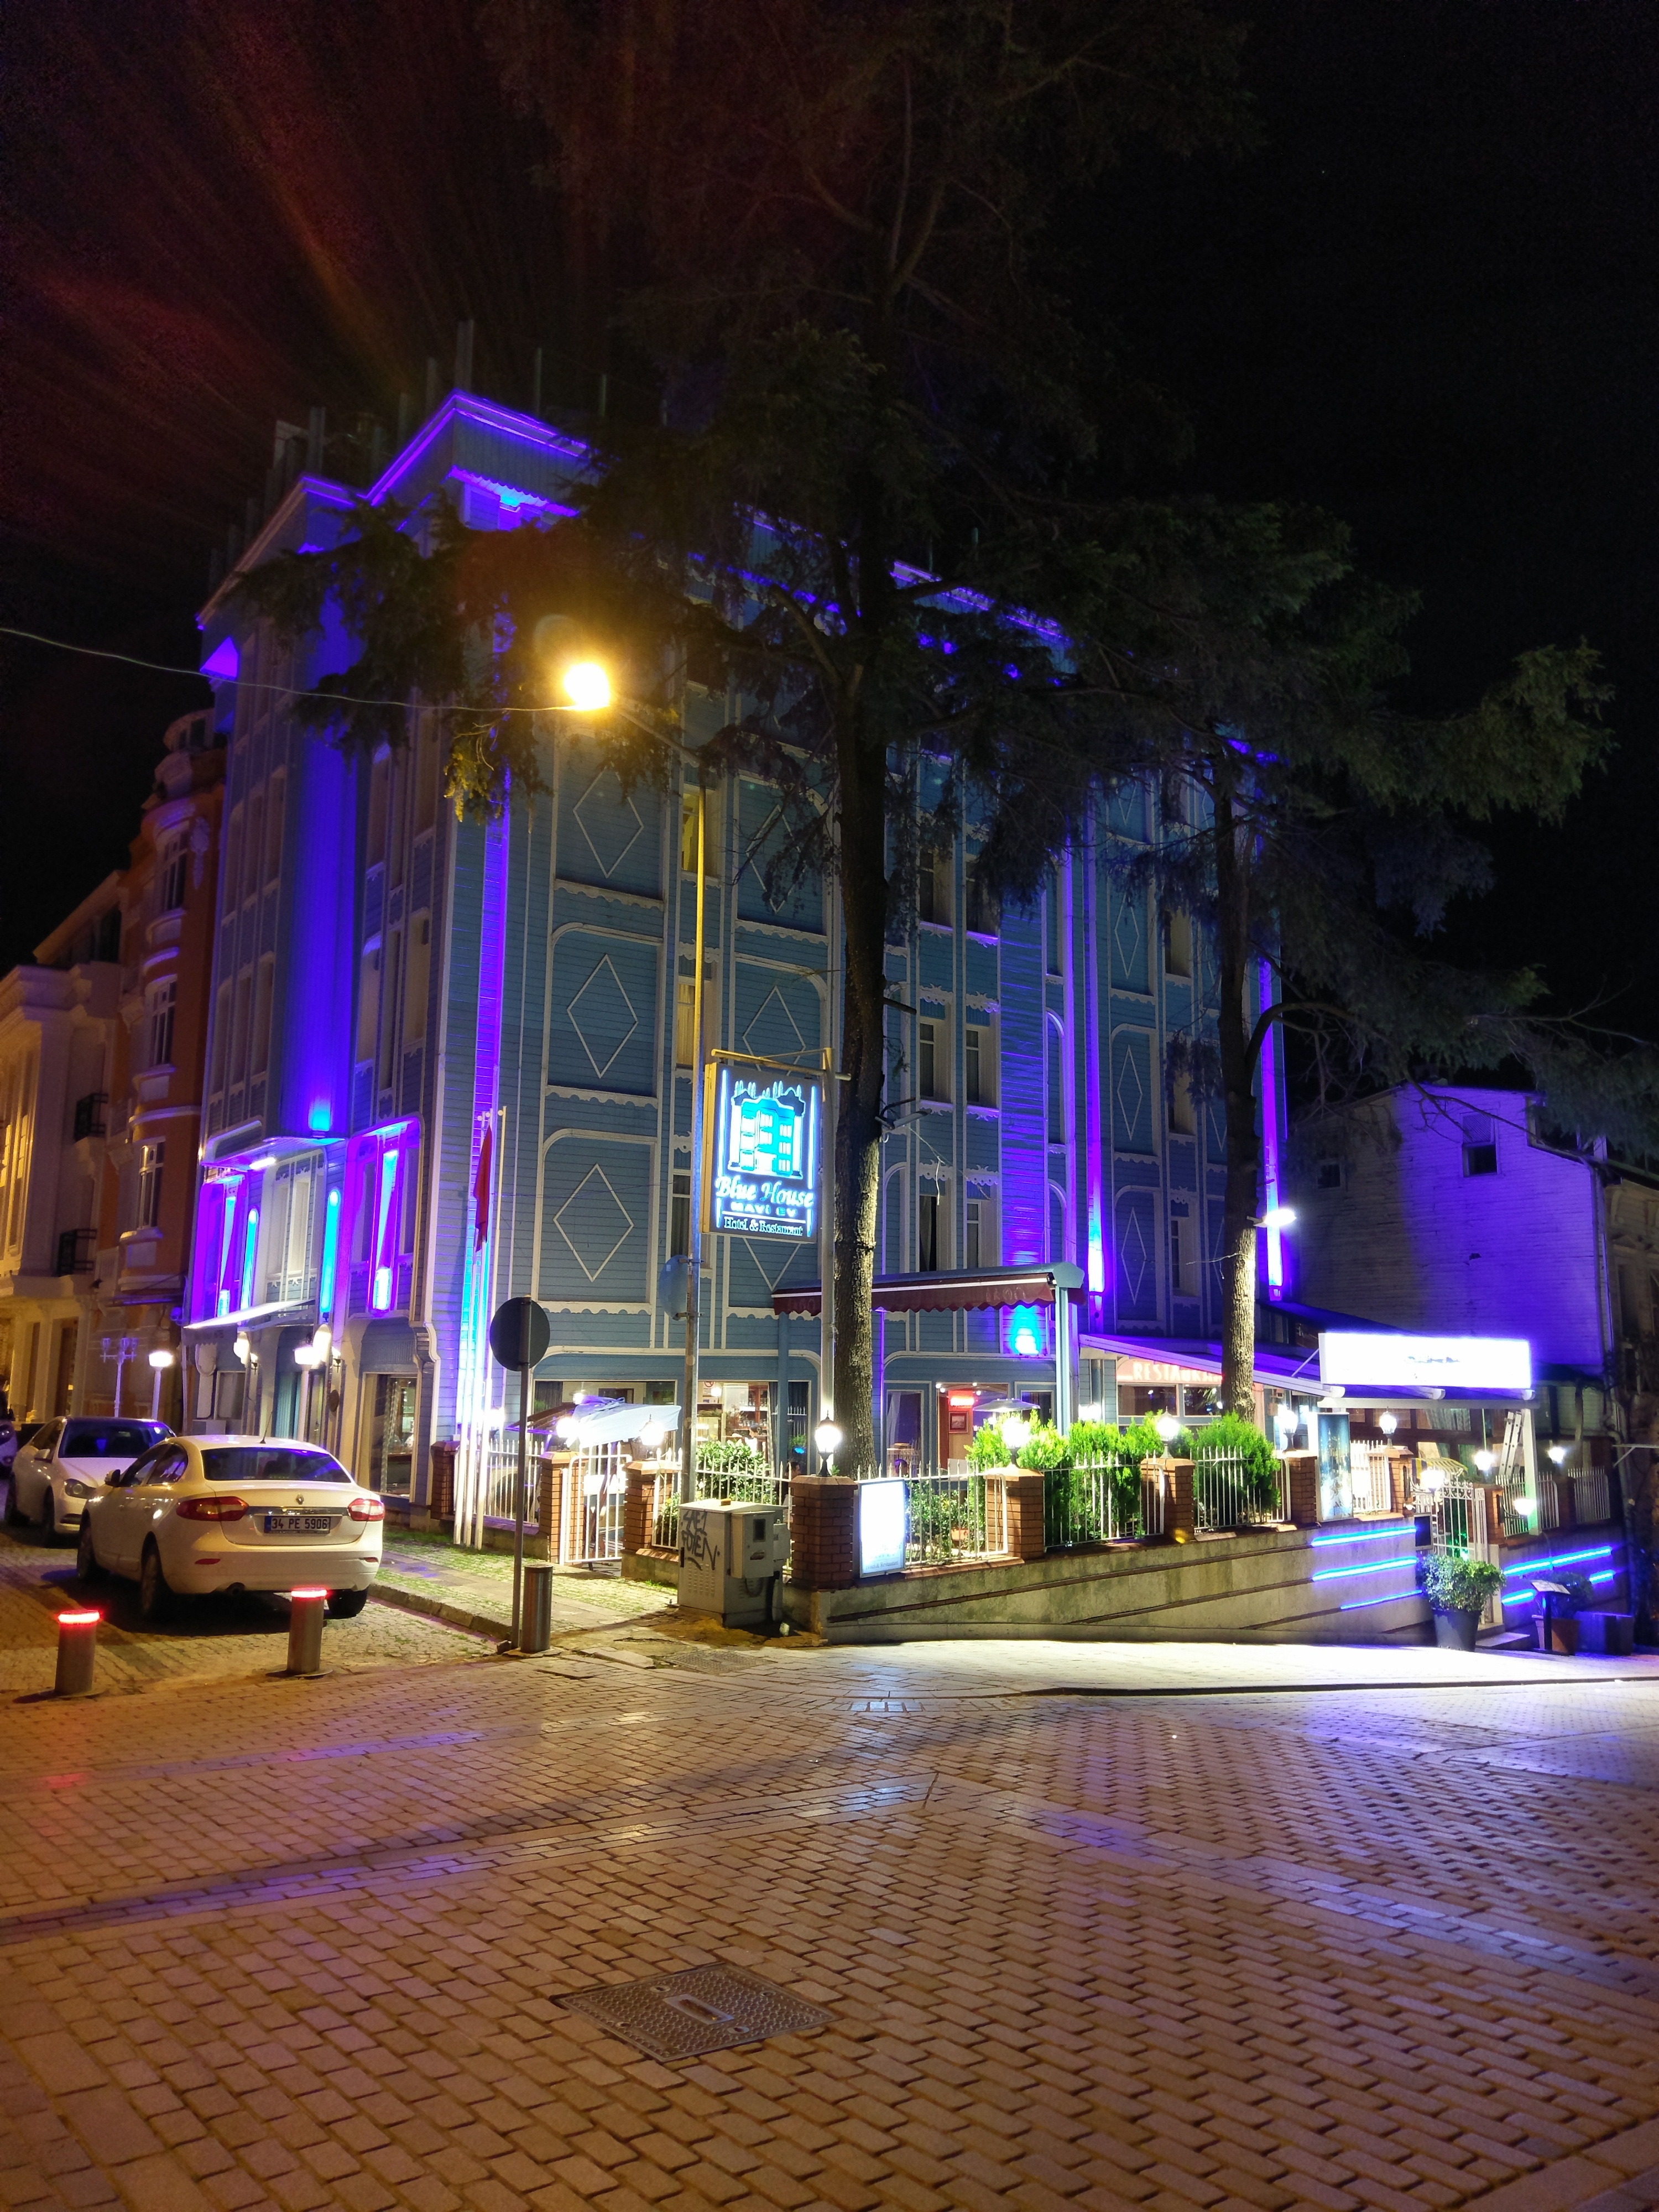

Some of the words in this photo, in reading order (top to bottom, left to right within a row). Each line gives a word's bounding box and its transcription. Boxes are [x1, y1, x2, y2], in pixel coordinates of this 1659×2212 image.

[716, 1175, 757, 1201] Blue
[760, 1181, 814, 1208] House
[724, 1217, 748, 1231] Hotel
[749, 1219, 759, 1232] &
[759, 1220, 803, 1237] Restaurant
[272, 1518, 284, 1529] 34
[288, 1518, 300, 1529] PE
[305, 1518, 327, 1529] 5906
